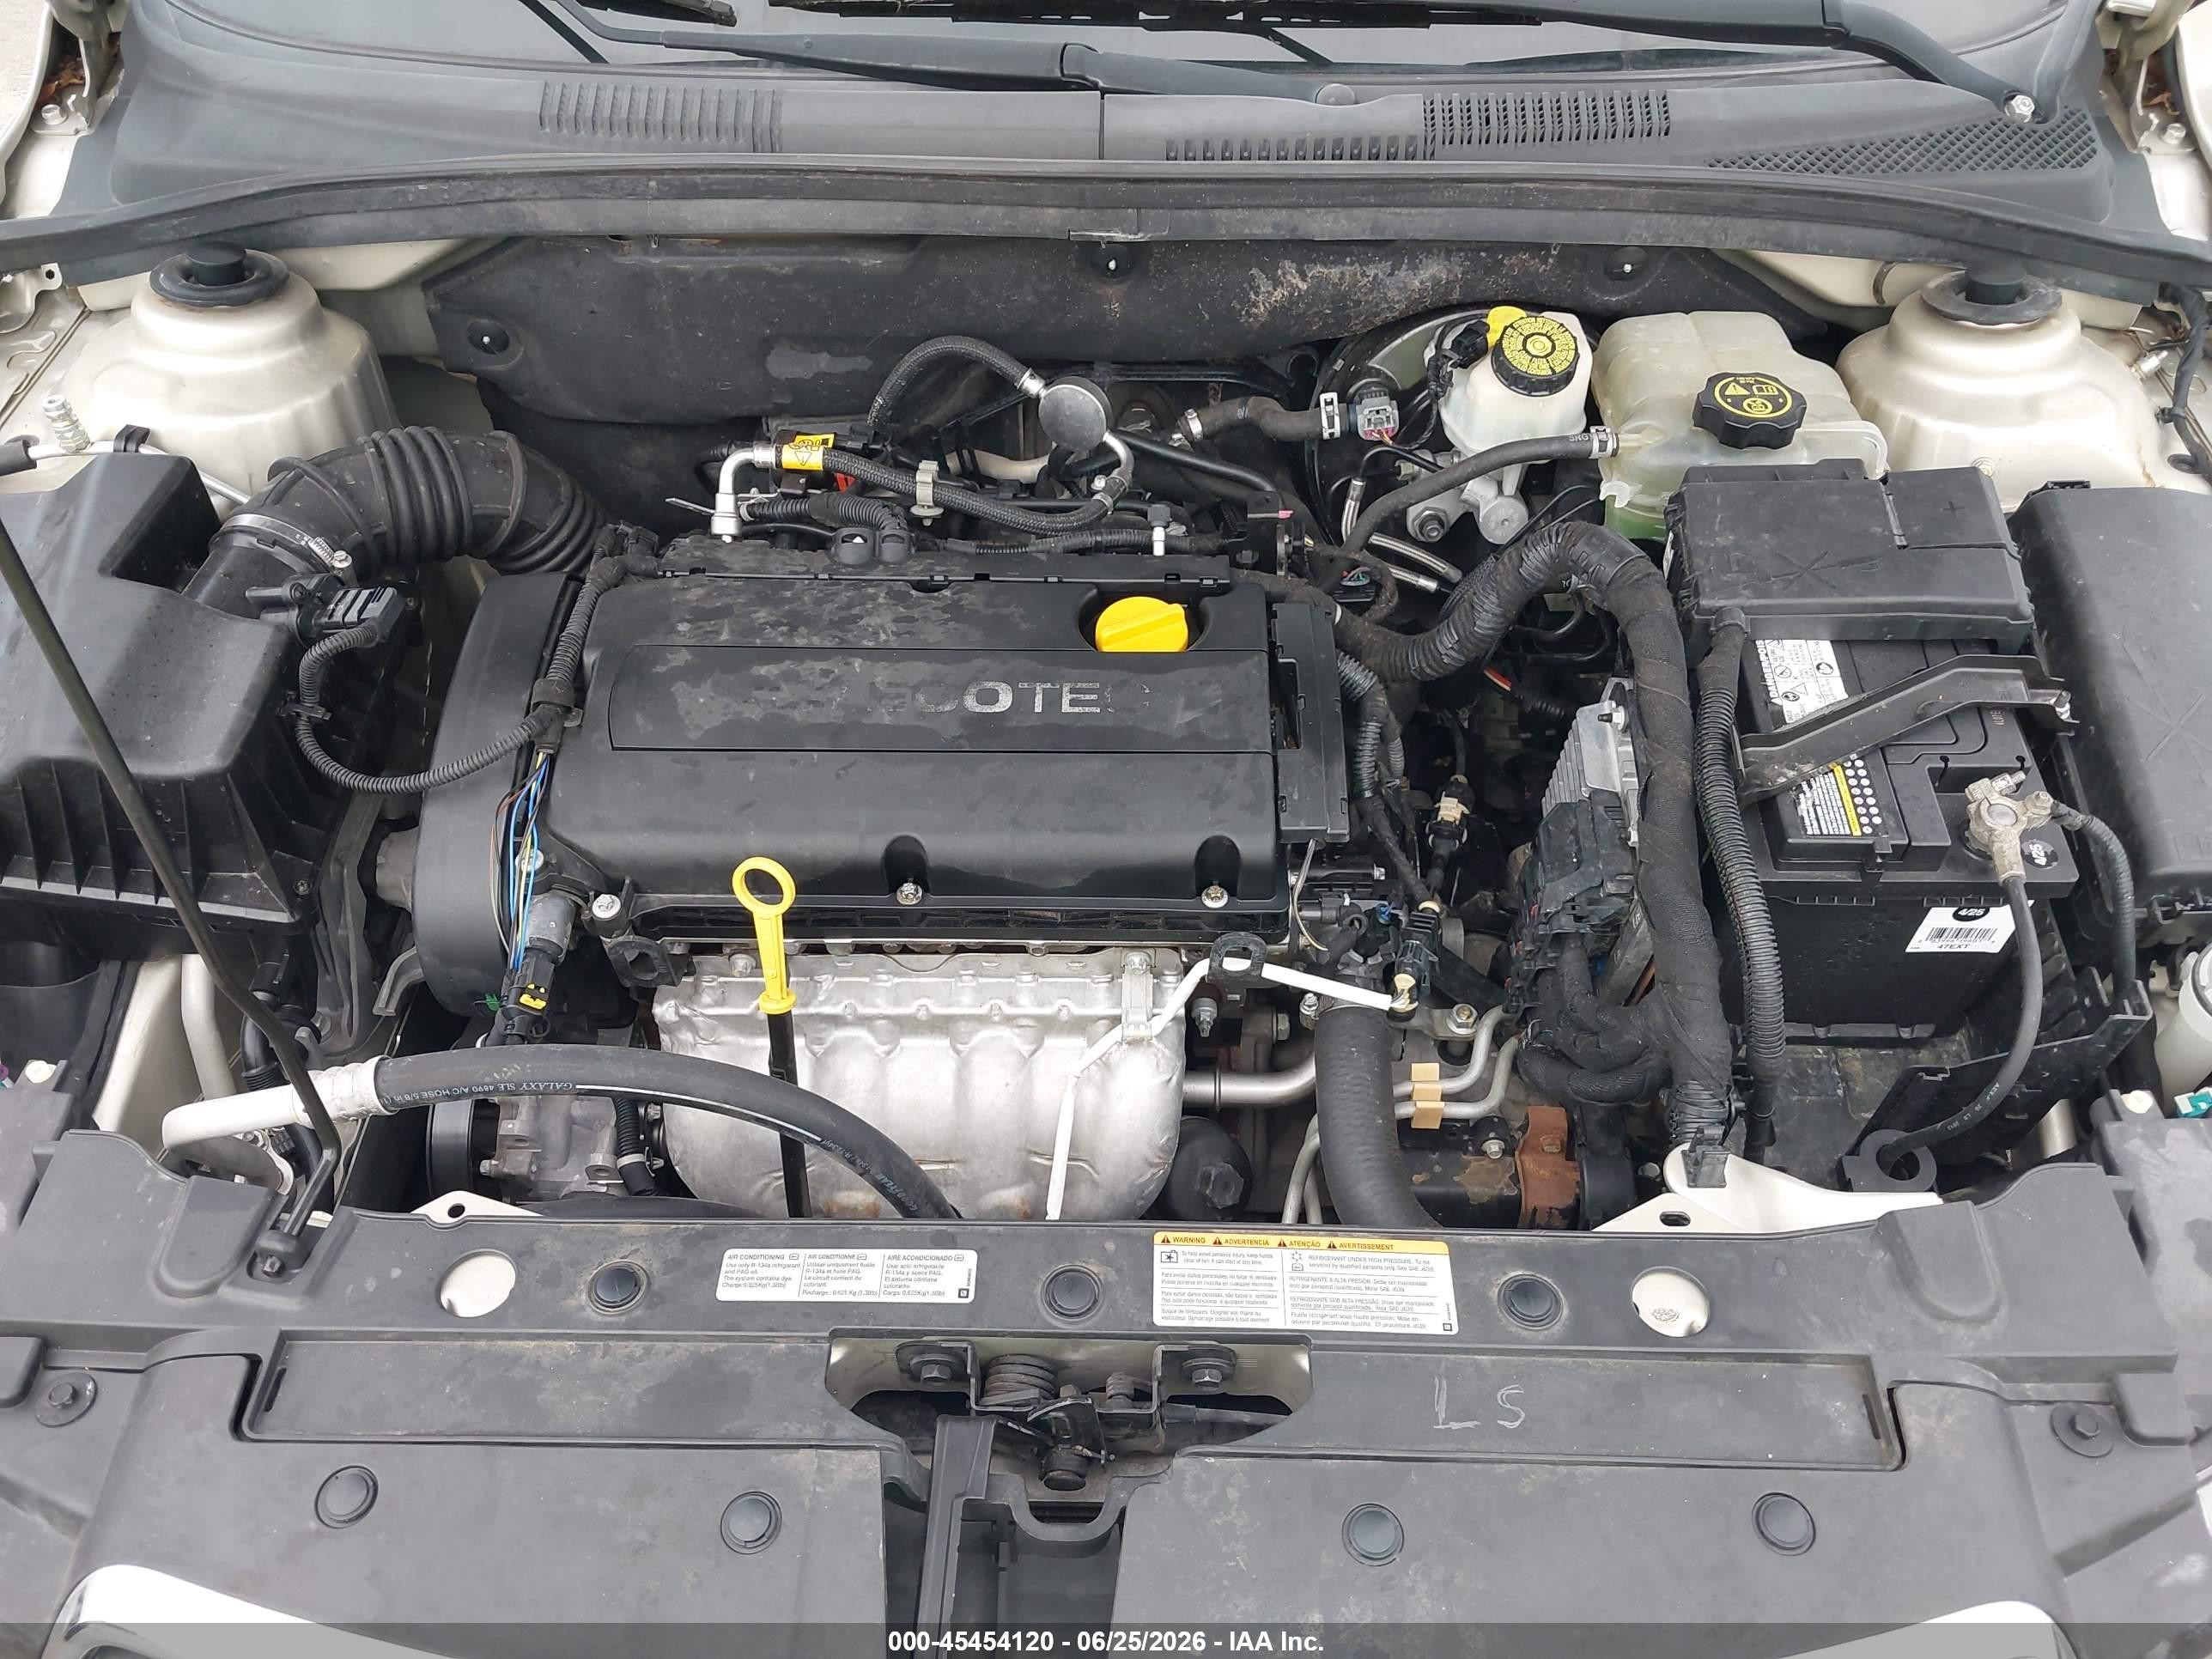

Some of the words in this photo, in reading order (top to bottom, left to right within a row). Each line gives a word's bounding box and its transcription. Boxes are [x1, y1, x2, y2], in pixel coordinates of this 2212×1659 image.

[1957, 908, 1985, 916] 4/25
[452, 1085, 470, 1096] A/C
[496, 1082, 515, 1091] SLE
[520, 1082, 573, 1091] GALAXY
[419, 1089, 450, 1100] HOSE
[873, 1173, 919, 1212] GOODYEAR
[1288, 1239, 1321, 1249] ATENÇÃO
